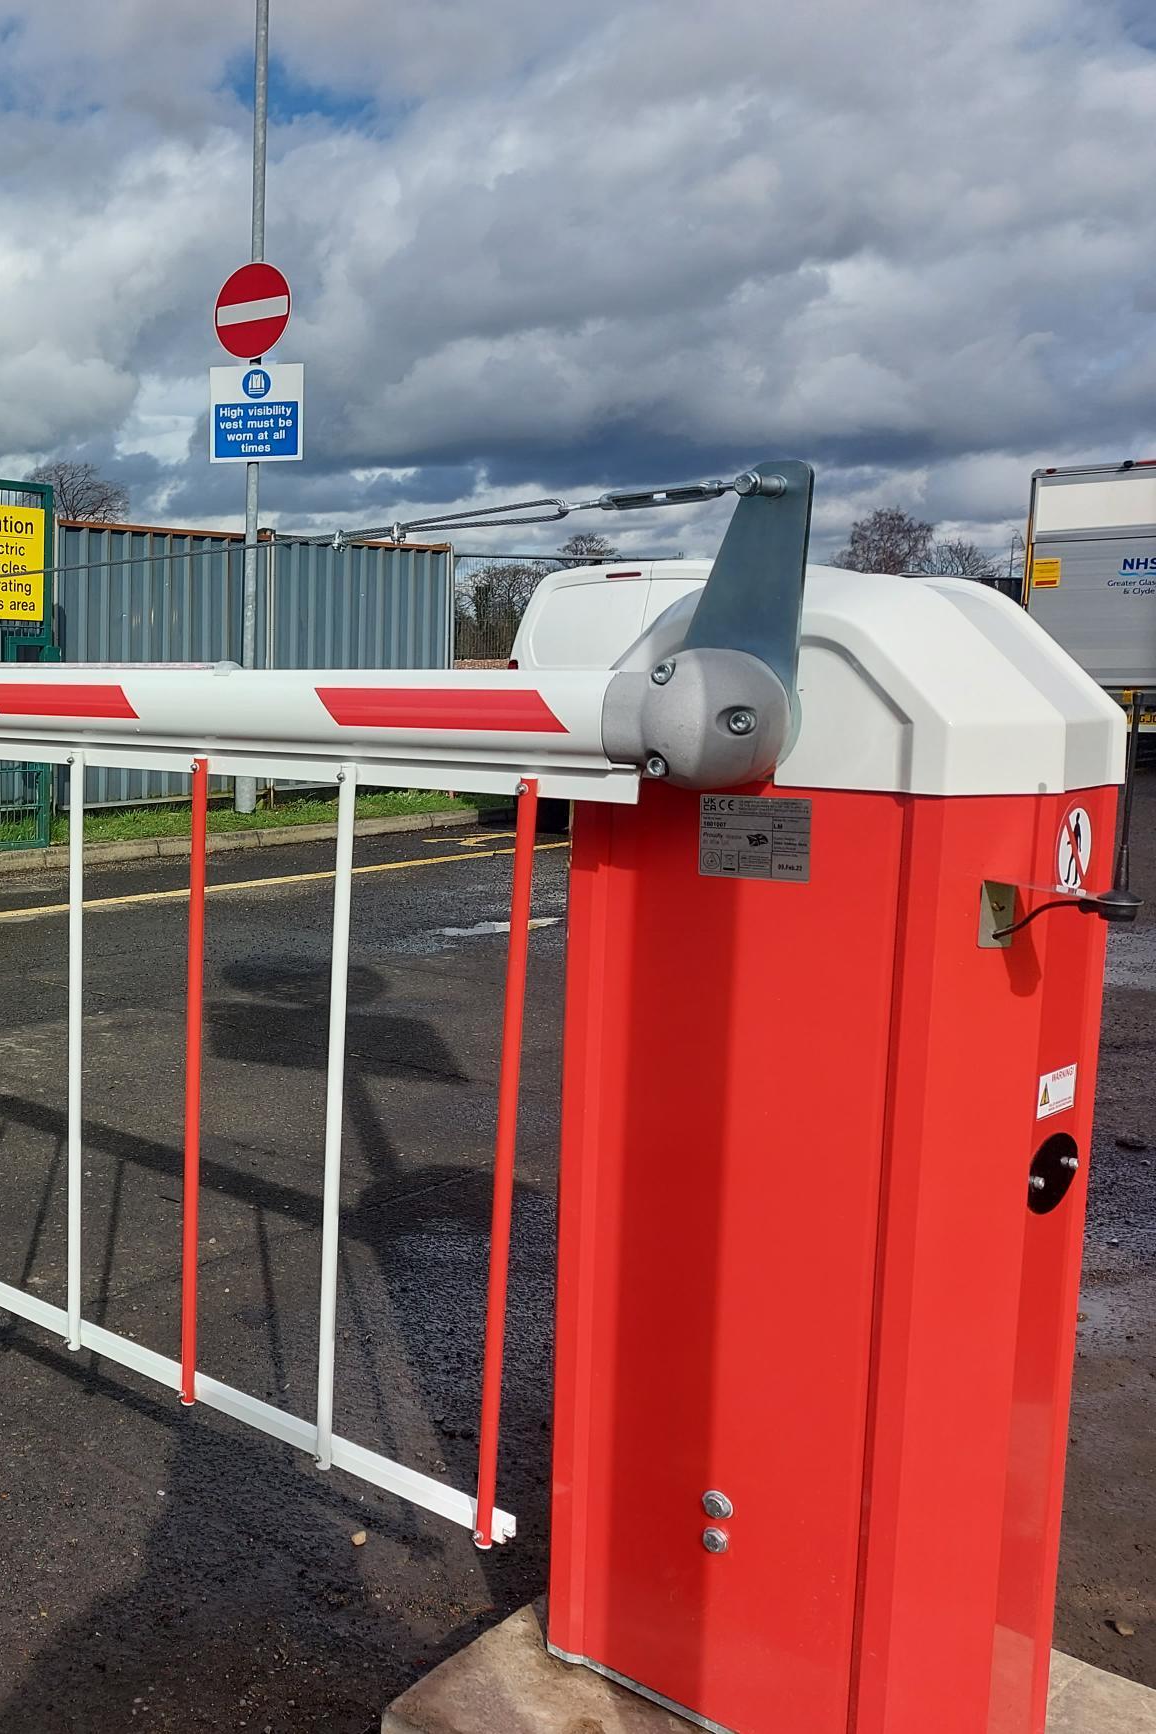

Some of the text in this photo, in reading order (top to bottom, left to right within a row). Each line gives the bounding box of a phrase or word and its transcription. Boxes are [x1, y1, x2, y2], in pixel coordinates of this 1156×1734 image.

[219, 405, 292, 419] High visibility
[219, 417, 293, 429] vest must be
[227, 429, 286, 441] worn at all
[241, 443, 271, 453] times
[1122, 558, 1156, 571] NHS
[1139, 579, 1156, 587] Glas
[1132, 587, 1155, 596] Clyde
[9, 600, 36, 611] area
[718, 799, 735, 811] CE
